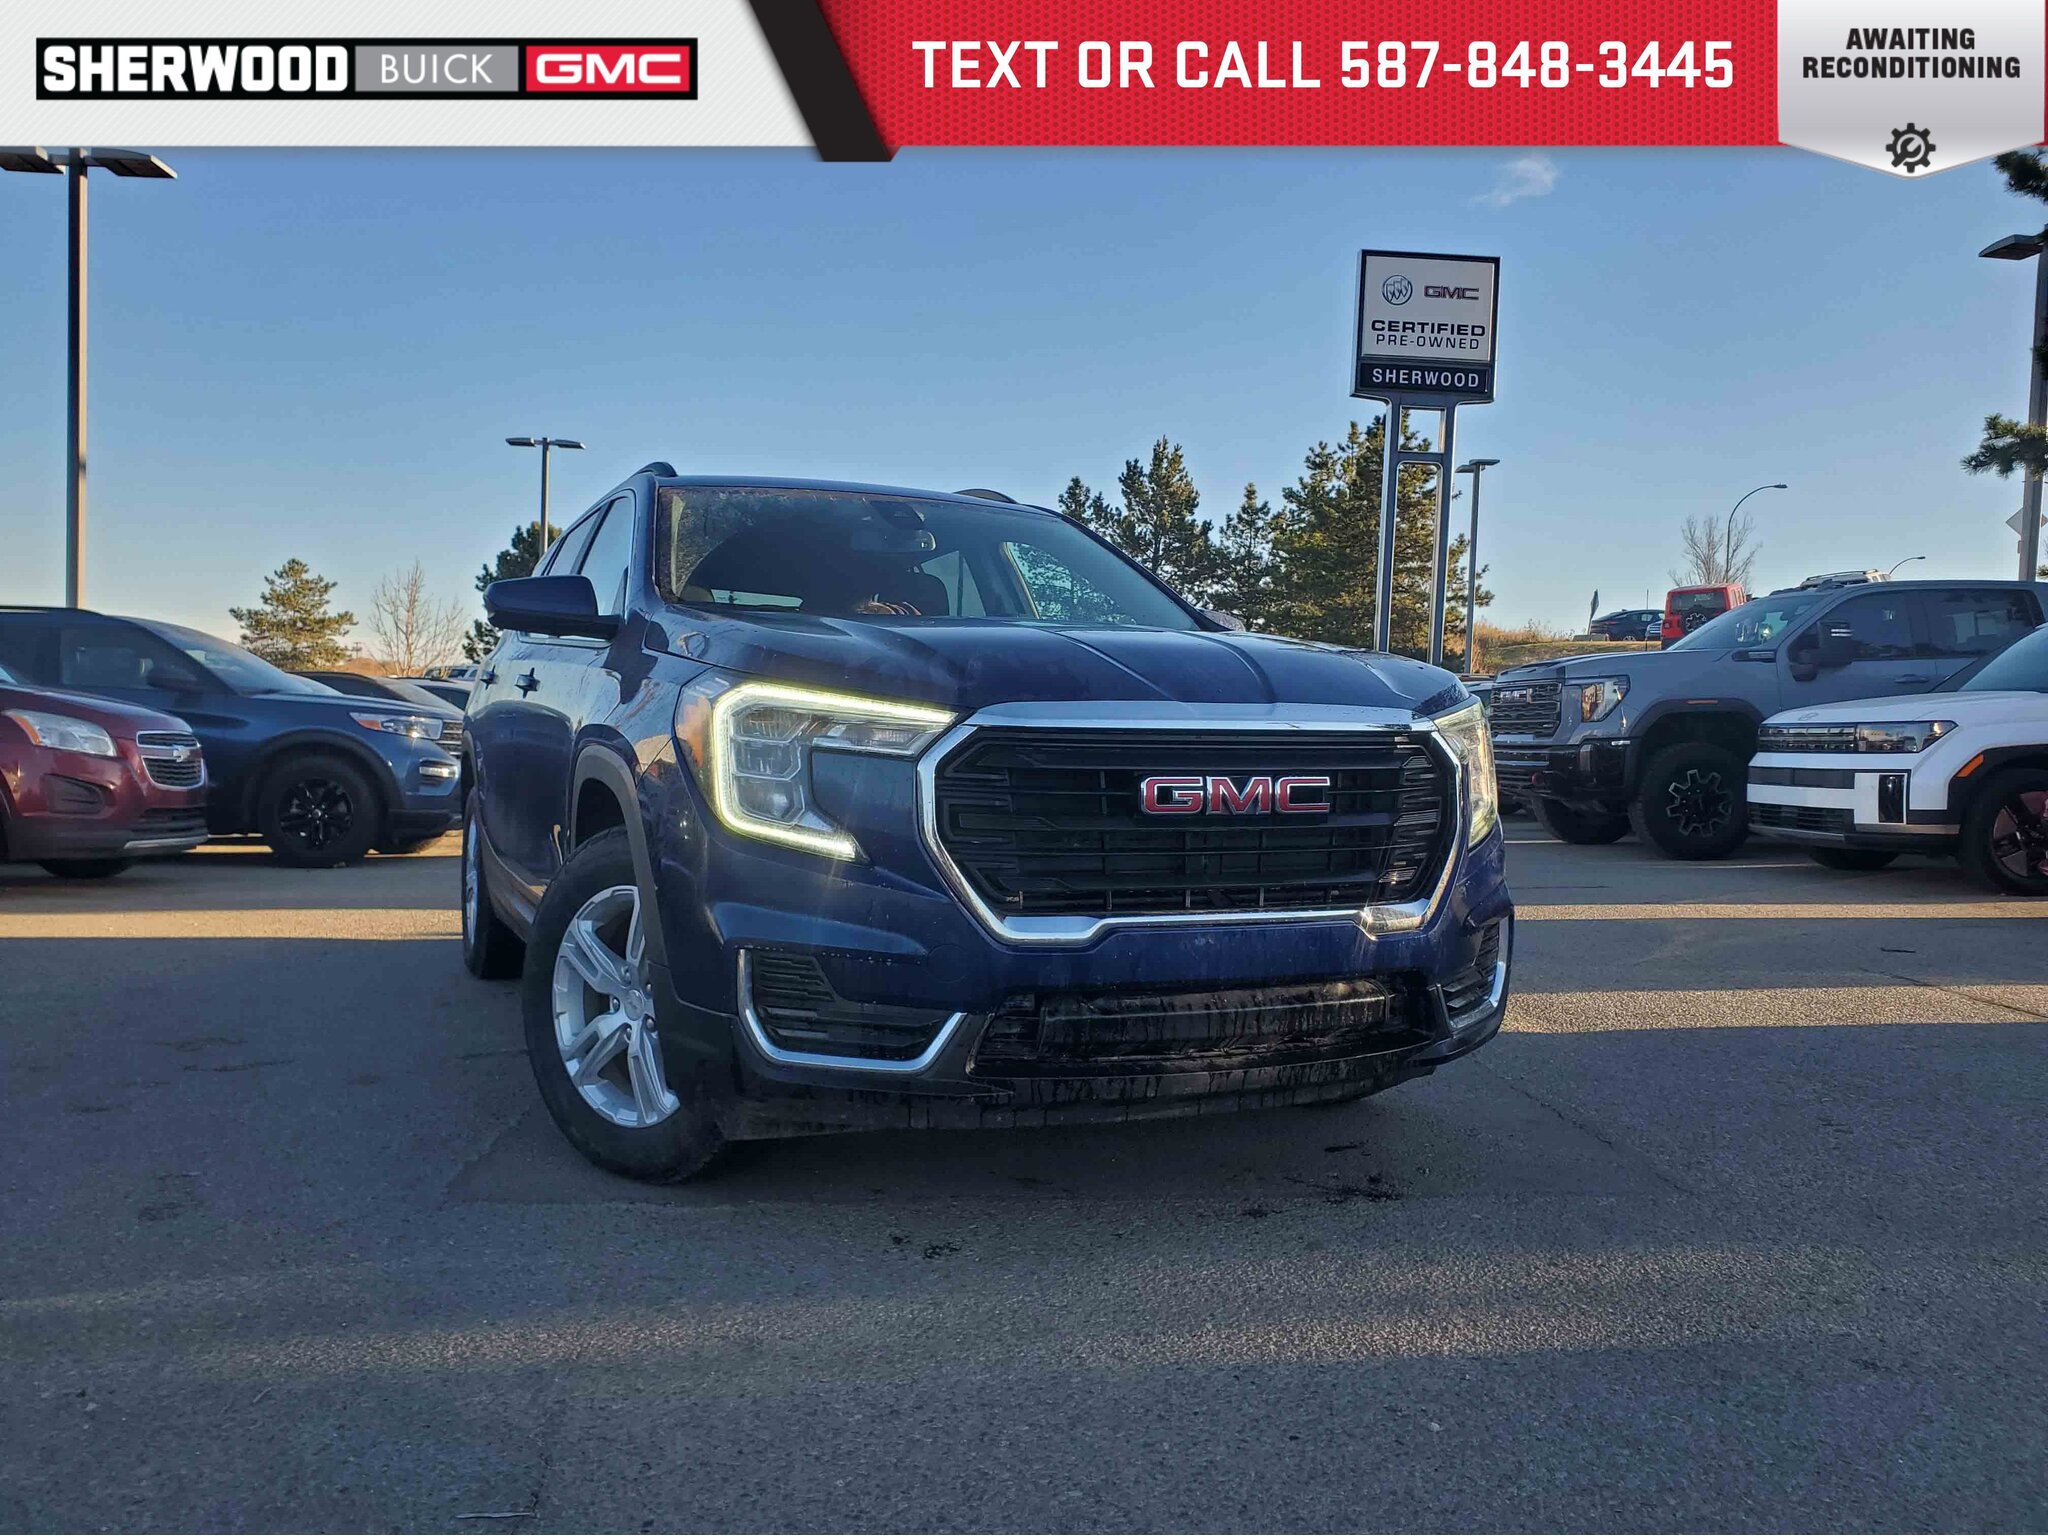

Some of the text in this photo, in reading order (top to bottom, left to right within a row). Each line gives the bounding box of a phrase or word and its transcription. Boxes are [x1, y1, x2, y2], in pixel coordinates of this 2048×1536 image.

[1423, 285, 1480, 301] GMC
[1371, 319, 1486, 337] CERTIFIED
[1376, 334, 1479, 350] PRE-OWNED
[1372, 368, 1479, 387] SHERWOOD
[1140, 775, 1331, 815] GMC
